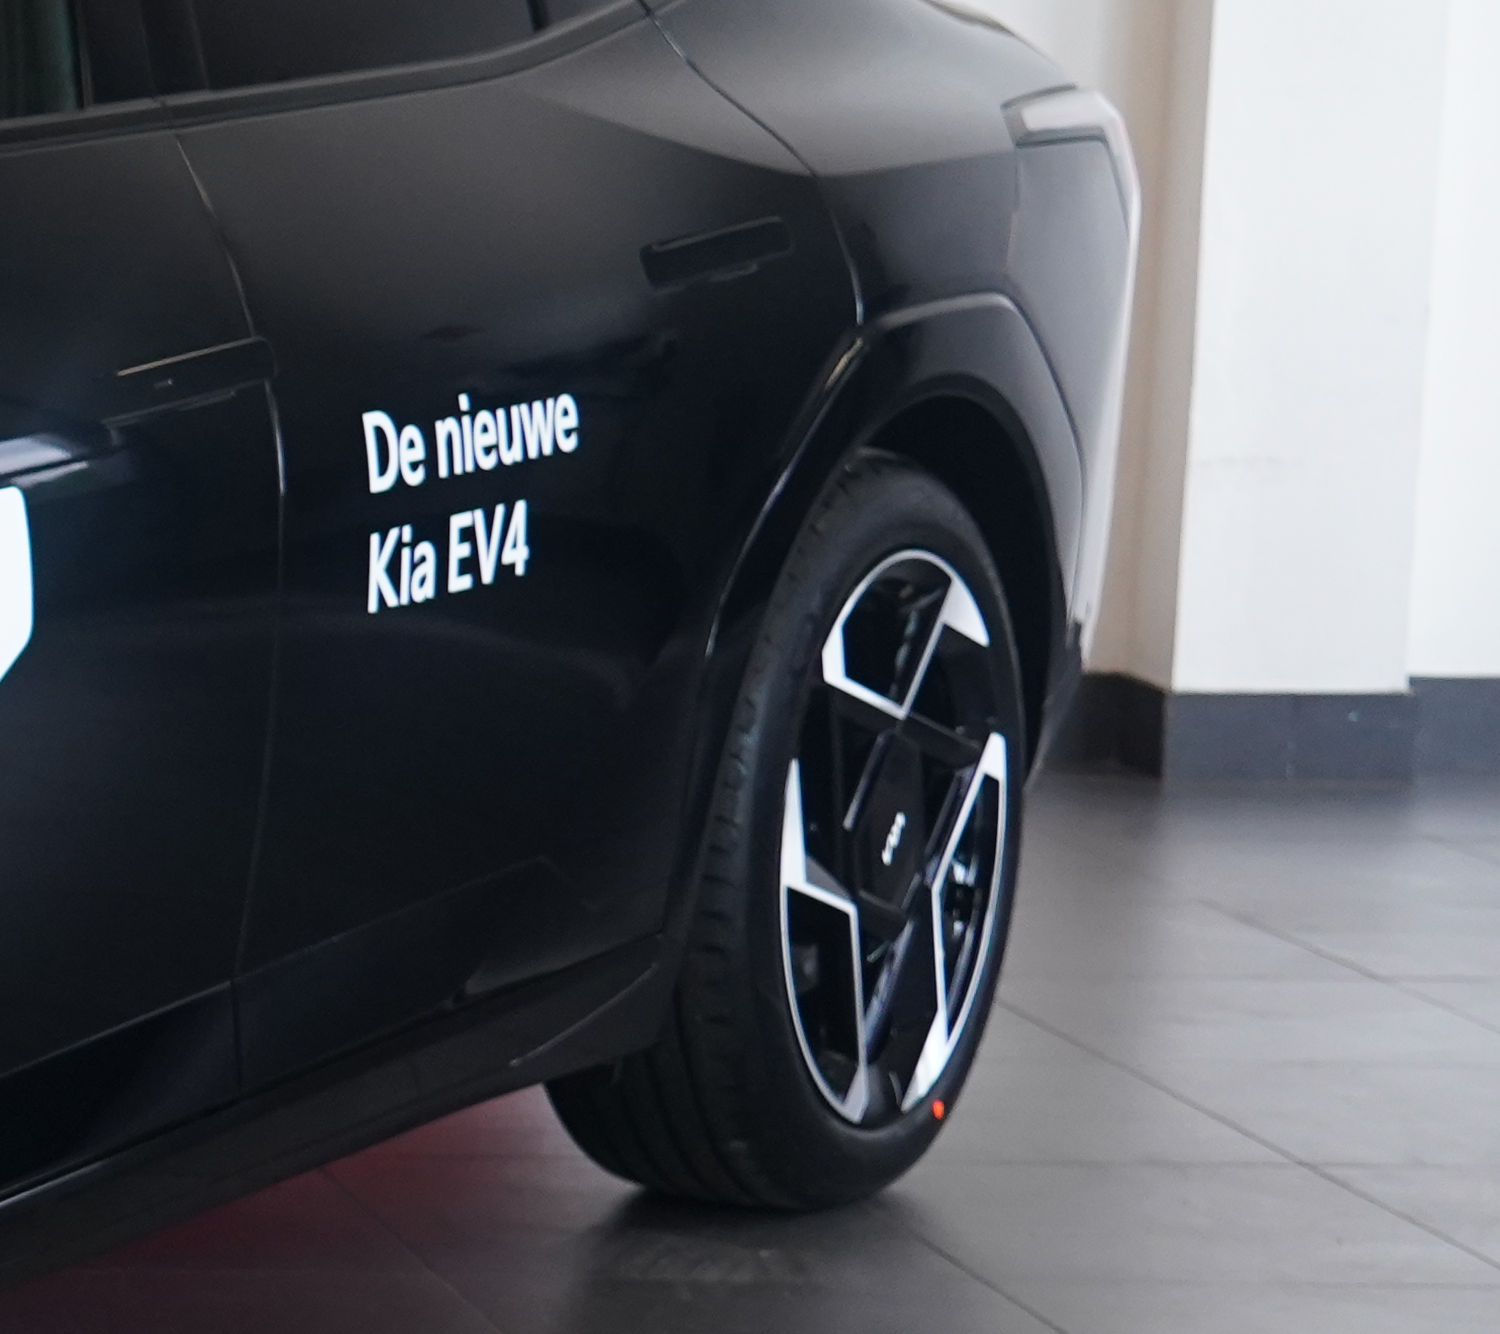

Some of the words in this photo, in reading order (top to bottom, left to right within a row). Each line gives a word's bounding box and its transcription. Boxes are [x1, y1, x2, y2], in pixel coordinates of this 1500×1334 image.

[362, 410, 426, 494] De
[435, 393, 579, 479] nieuwe
[367, 524, 437, 614] Kia
[447, 499, 529, 593] EV4
